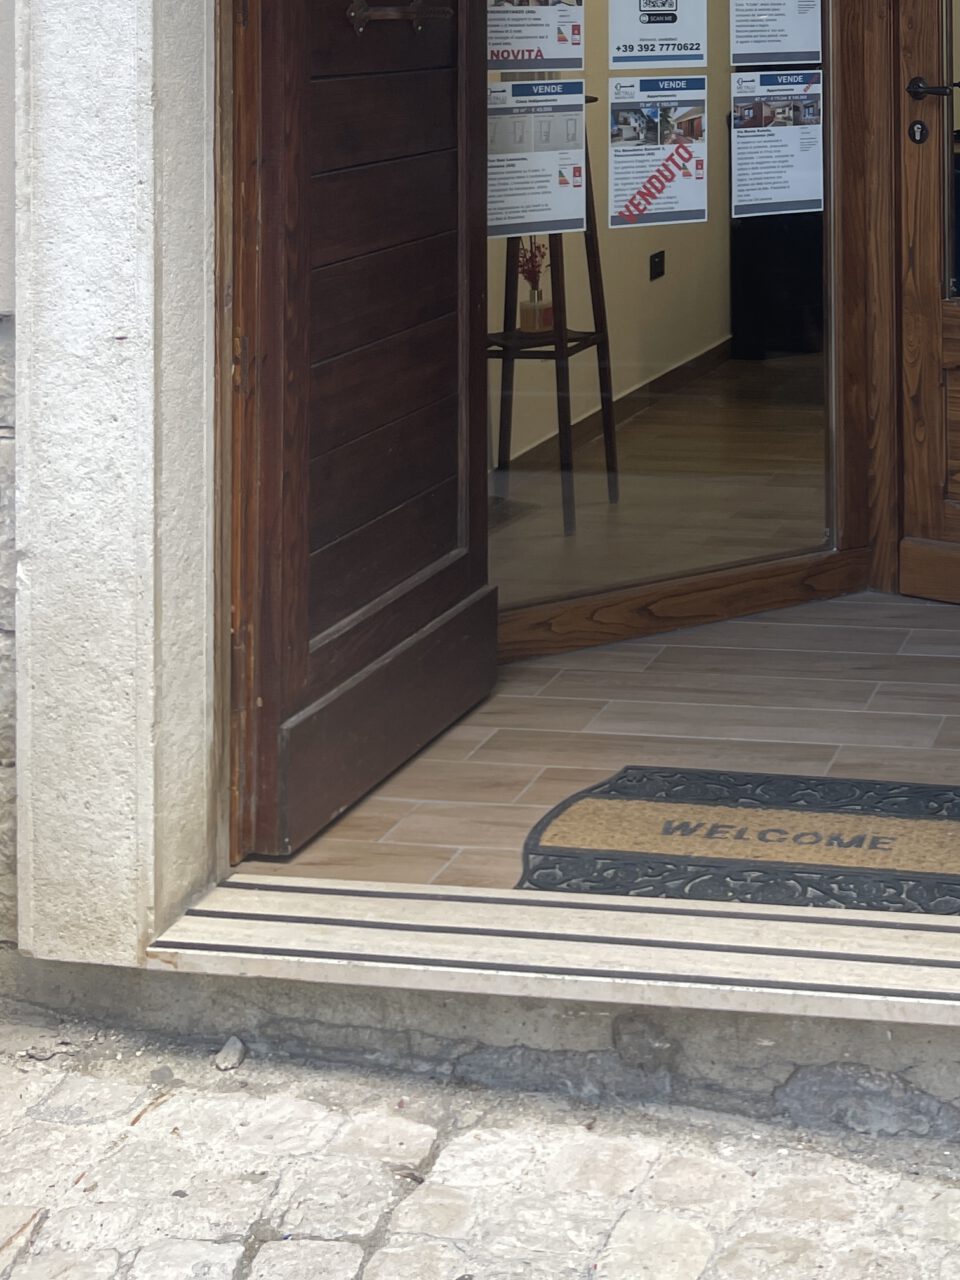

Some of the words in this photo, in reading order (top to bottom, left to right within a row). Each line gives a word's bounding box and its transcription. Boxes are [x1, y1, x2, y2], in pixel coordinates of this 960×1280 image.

[490, 46, 544, 60] NOVITÀ
[615, 44, 634, 53] +39
[637, 43, 656, 52] 392
[658, 42, 701, 51] 7770622
[658, 80, 687, 89] VENDE
[777, 75, 804, 83] VENDE
[532, 84, 563, 93] VENDE
[618, 143, 693, 224] VENDUTO
[660, 819, 898, 851] WELCOME
